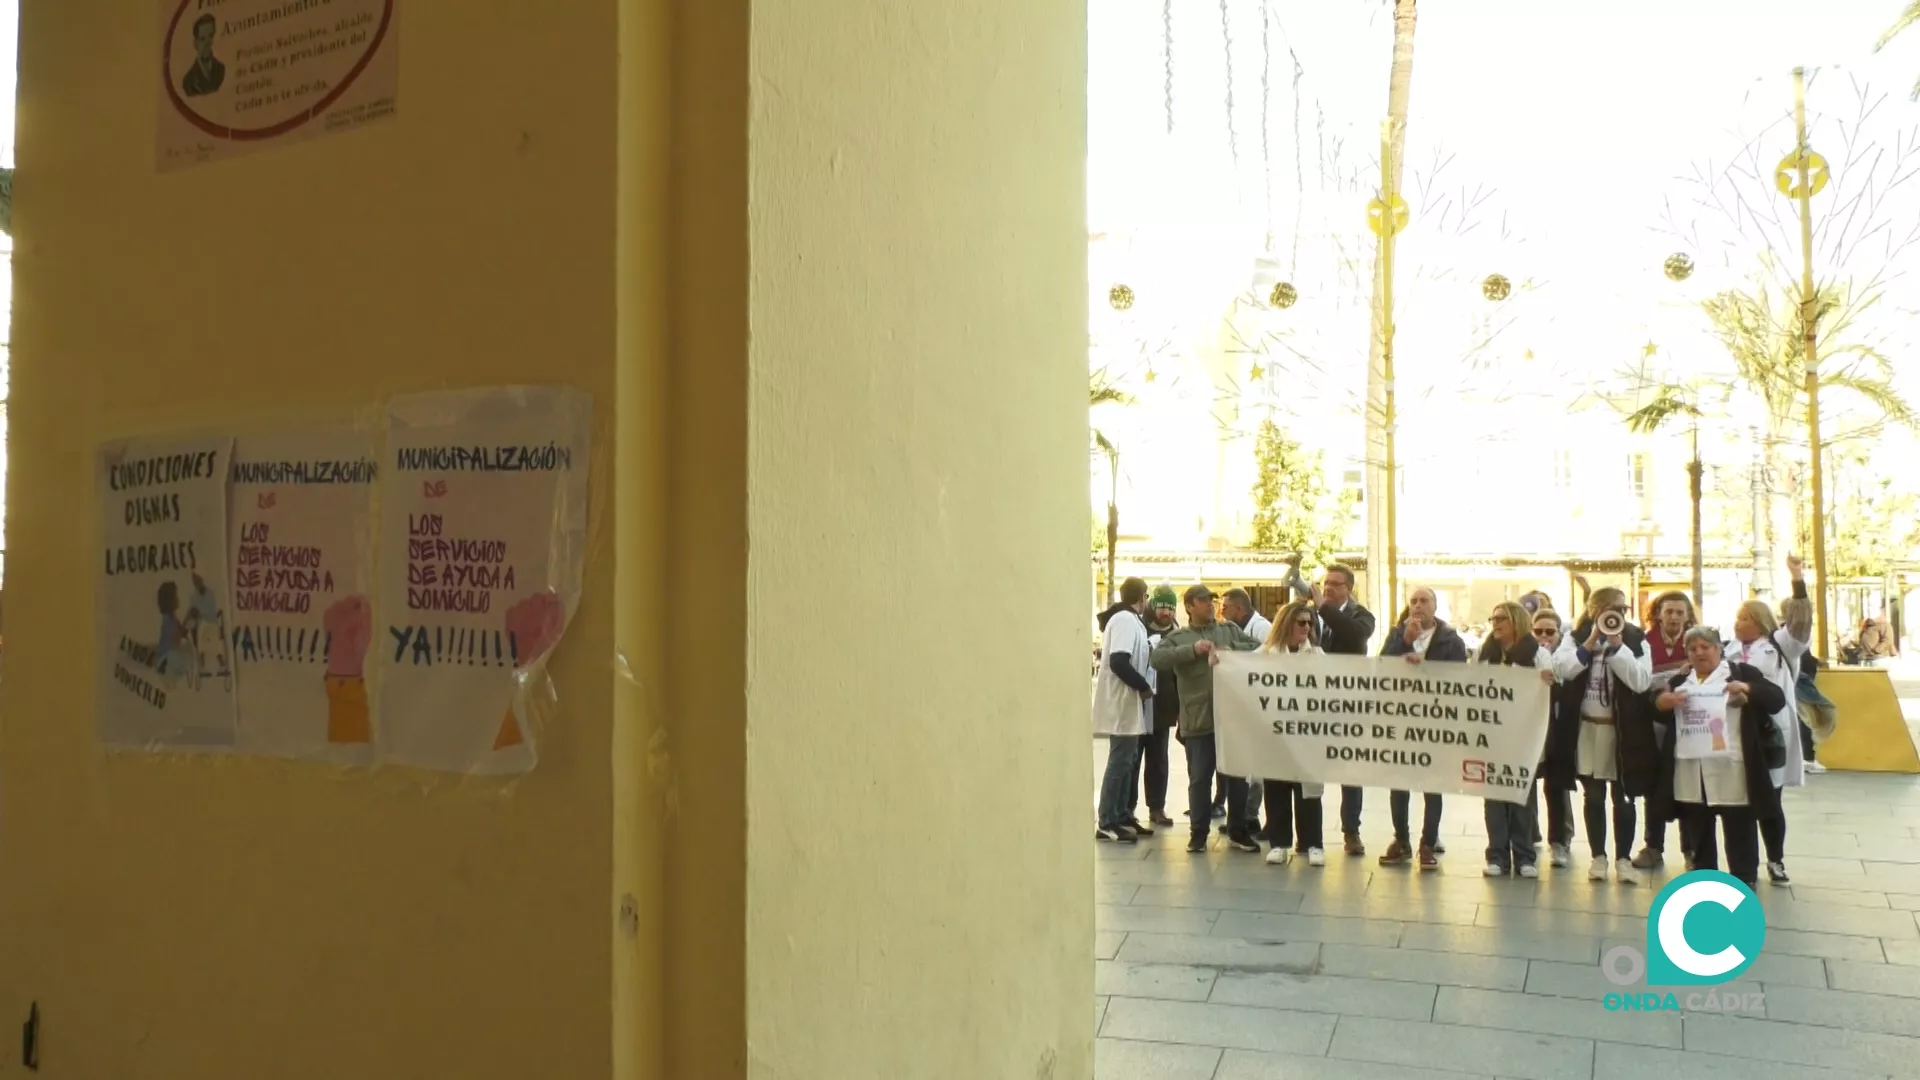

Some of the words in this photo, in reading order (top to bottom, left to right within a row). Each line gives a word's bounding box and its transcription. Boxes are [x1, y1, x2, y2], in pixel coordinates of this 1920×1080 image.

[233, 456, 379, 484] MUNICIPALIZACIÓN
[397, 441, 571, 471] MUNICIPALIZACIÓN
[110, 451, 217, 491] CONDICIONES
[257, 492, 276, 509] DE
[424, 480, 448, 498] DE
[125, 494, 180, 526] DIGNAS
[241, 522, 269, 543] LOS
[409, 513, 443, 536] LOS
[106, 541, 197, 576] LABORALES
[238, 544, 322, 568] SERVICIOS
[408, 538, 506, 563] SERVICIOS
[236, 567, 261, 588] DE
[264, 569, 320, 592] AYUDA
[324, 570, 334, 593] A
[408, 562, 437, 586] DE
[442, 563, 500, 590] AYUDA
[503, 565, 515, 590] A
[236, 590, 311, 614] DOMICILIO
[408, 587, 491, 615] DOMICILIO
[114, 662, 167, 711] DOMICILIO
[1247, 671, 1288, 688] POR
[1295, 673, 1318, 688] LA
[1325, 674, 1514, 702] MUNICIPALIZACIÓN
[1259, 696, 1270, 711] Y
[1277, 696, 1300, 711] LA
[1306, 697, 1459, 721] DIGNIFICACIÓN
[1466, 708, 1503, 726] DEL
[1272, 720, 1364, 738] SERVICIO
[1371, 724, 1397, 740] DE
[1404, 727, 1469, 747] AYUDA
[1475, 733, 1490, 749] A
[1326, 745, 1433, 767] DOMICILIO
